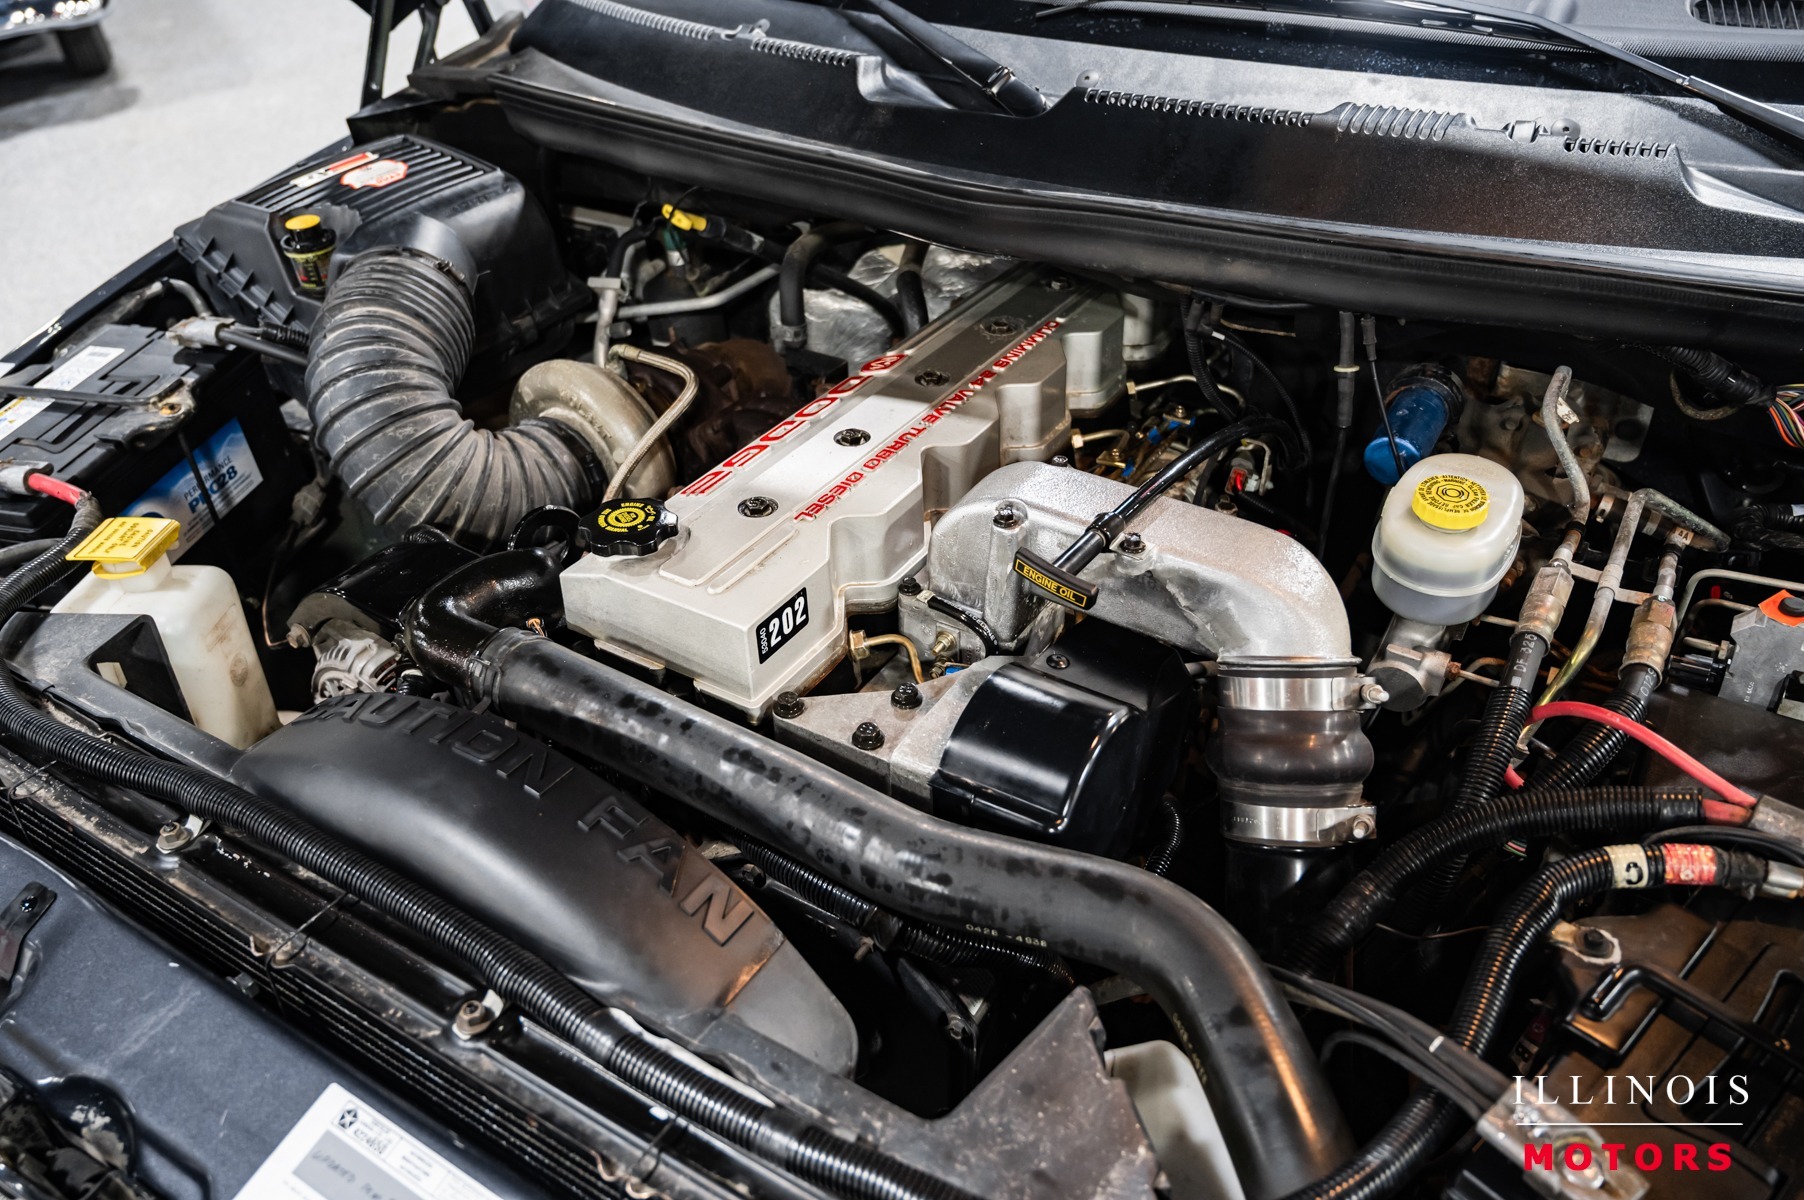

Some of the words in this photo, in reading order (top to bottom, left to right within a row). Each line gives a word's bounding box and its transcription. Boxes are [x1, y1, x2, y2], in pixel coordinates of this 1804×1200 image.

[922, 388, 974, 424] VALVE
[681, 375, 874, 495] DODGE
[863, 426, 928, 471] TURBO
[184, 456, 232, 501] PERRMANCE
[794, 471, 865, 521] DIESEL
[1023, 566, 1057, 591] ENGINE
[1059, 586, 1076, 601] OIL
[760, 627, 769, 655] 53040
[768, 596, 807, 648] 202
[577, 795, 755, 947] FAN
